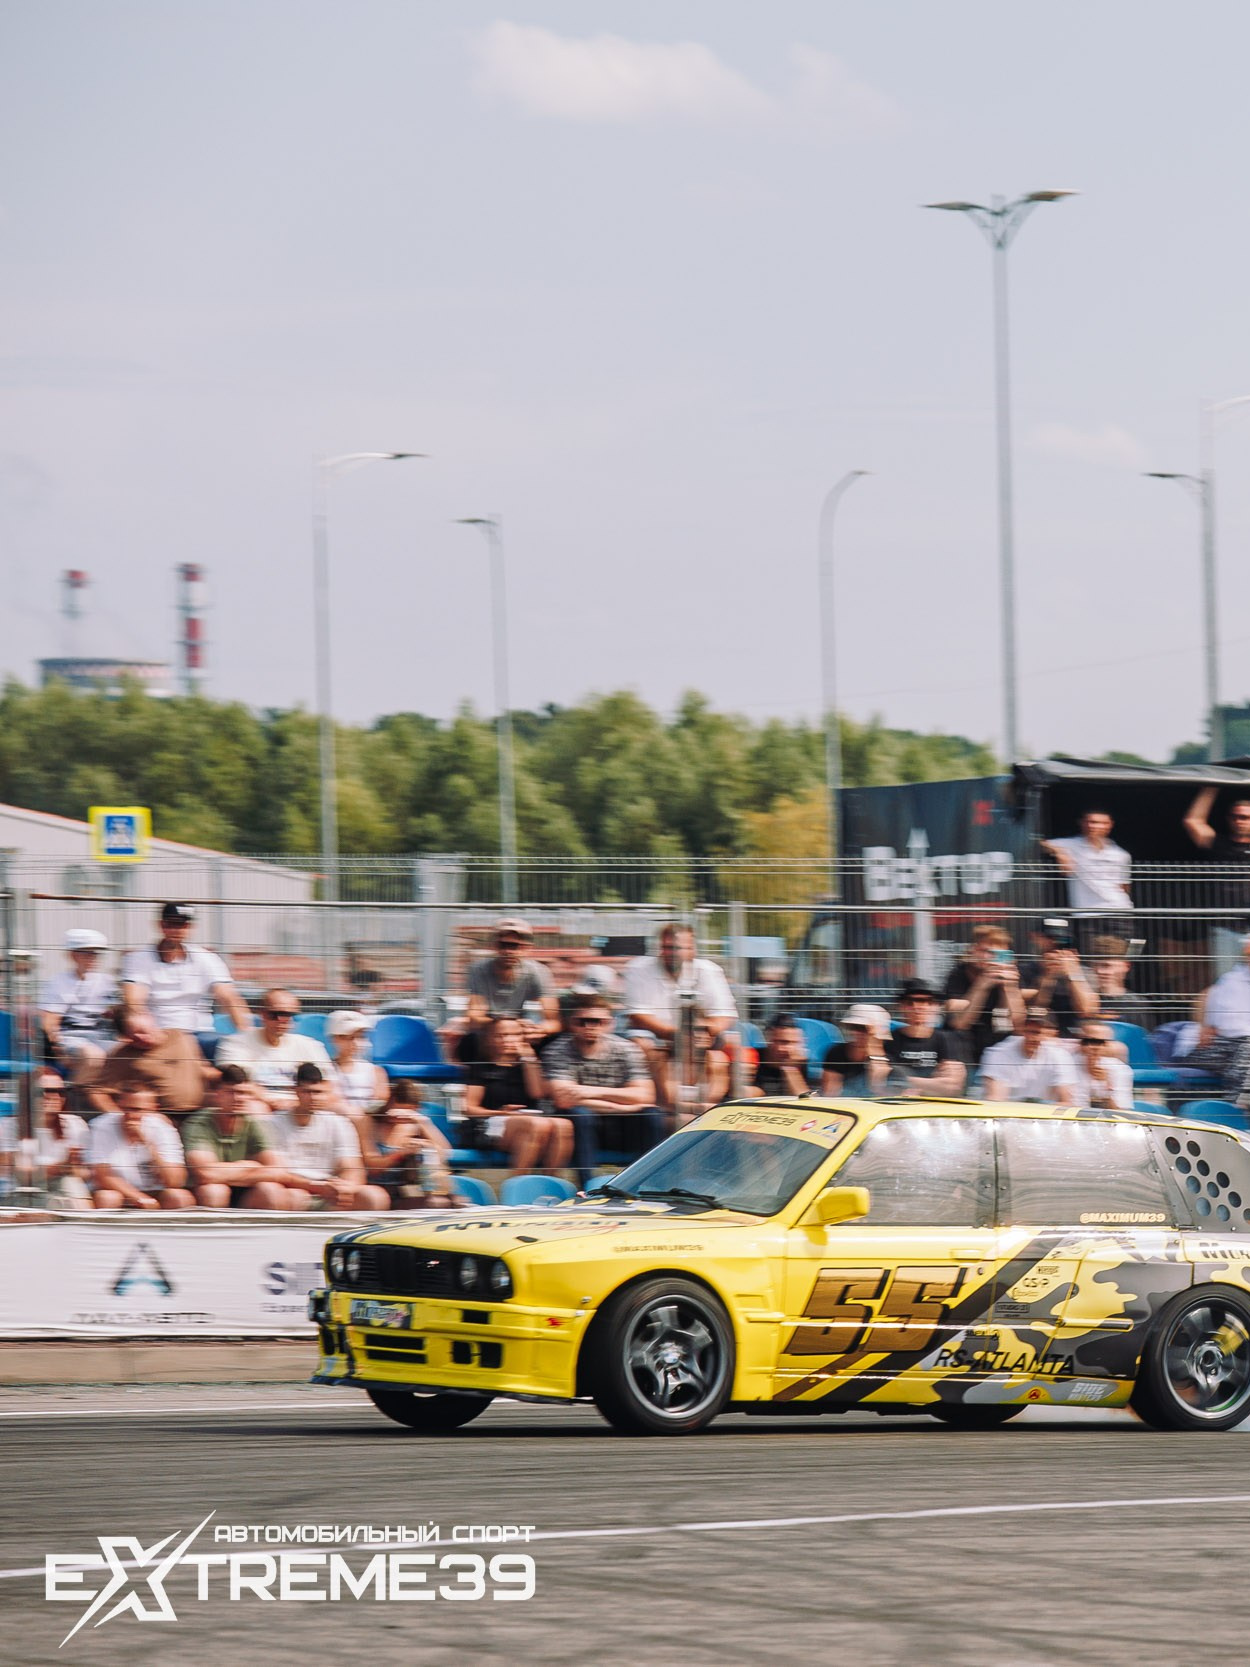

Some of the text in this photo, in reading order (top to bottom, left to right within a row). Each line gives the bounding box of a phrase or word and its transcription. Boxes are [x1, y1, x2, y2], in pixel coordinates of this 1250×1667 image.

[1080, 1212, 1166, 1224] @MAXIMUM39
[784, 1264, 962, 1356] 55
[933, 1348, 1075, 1375] RS-ATLANTA
